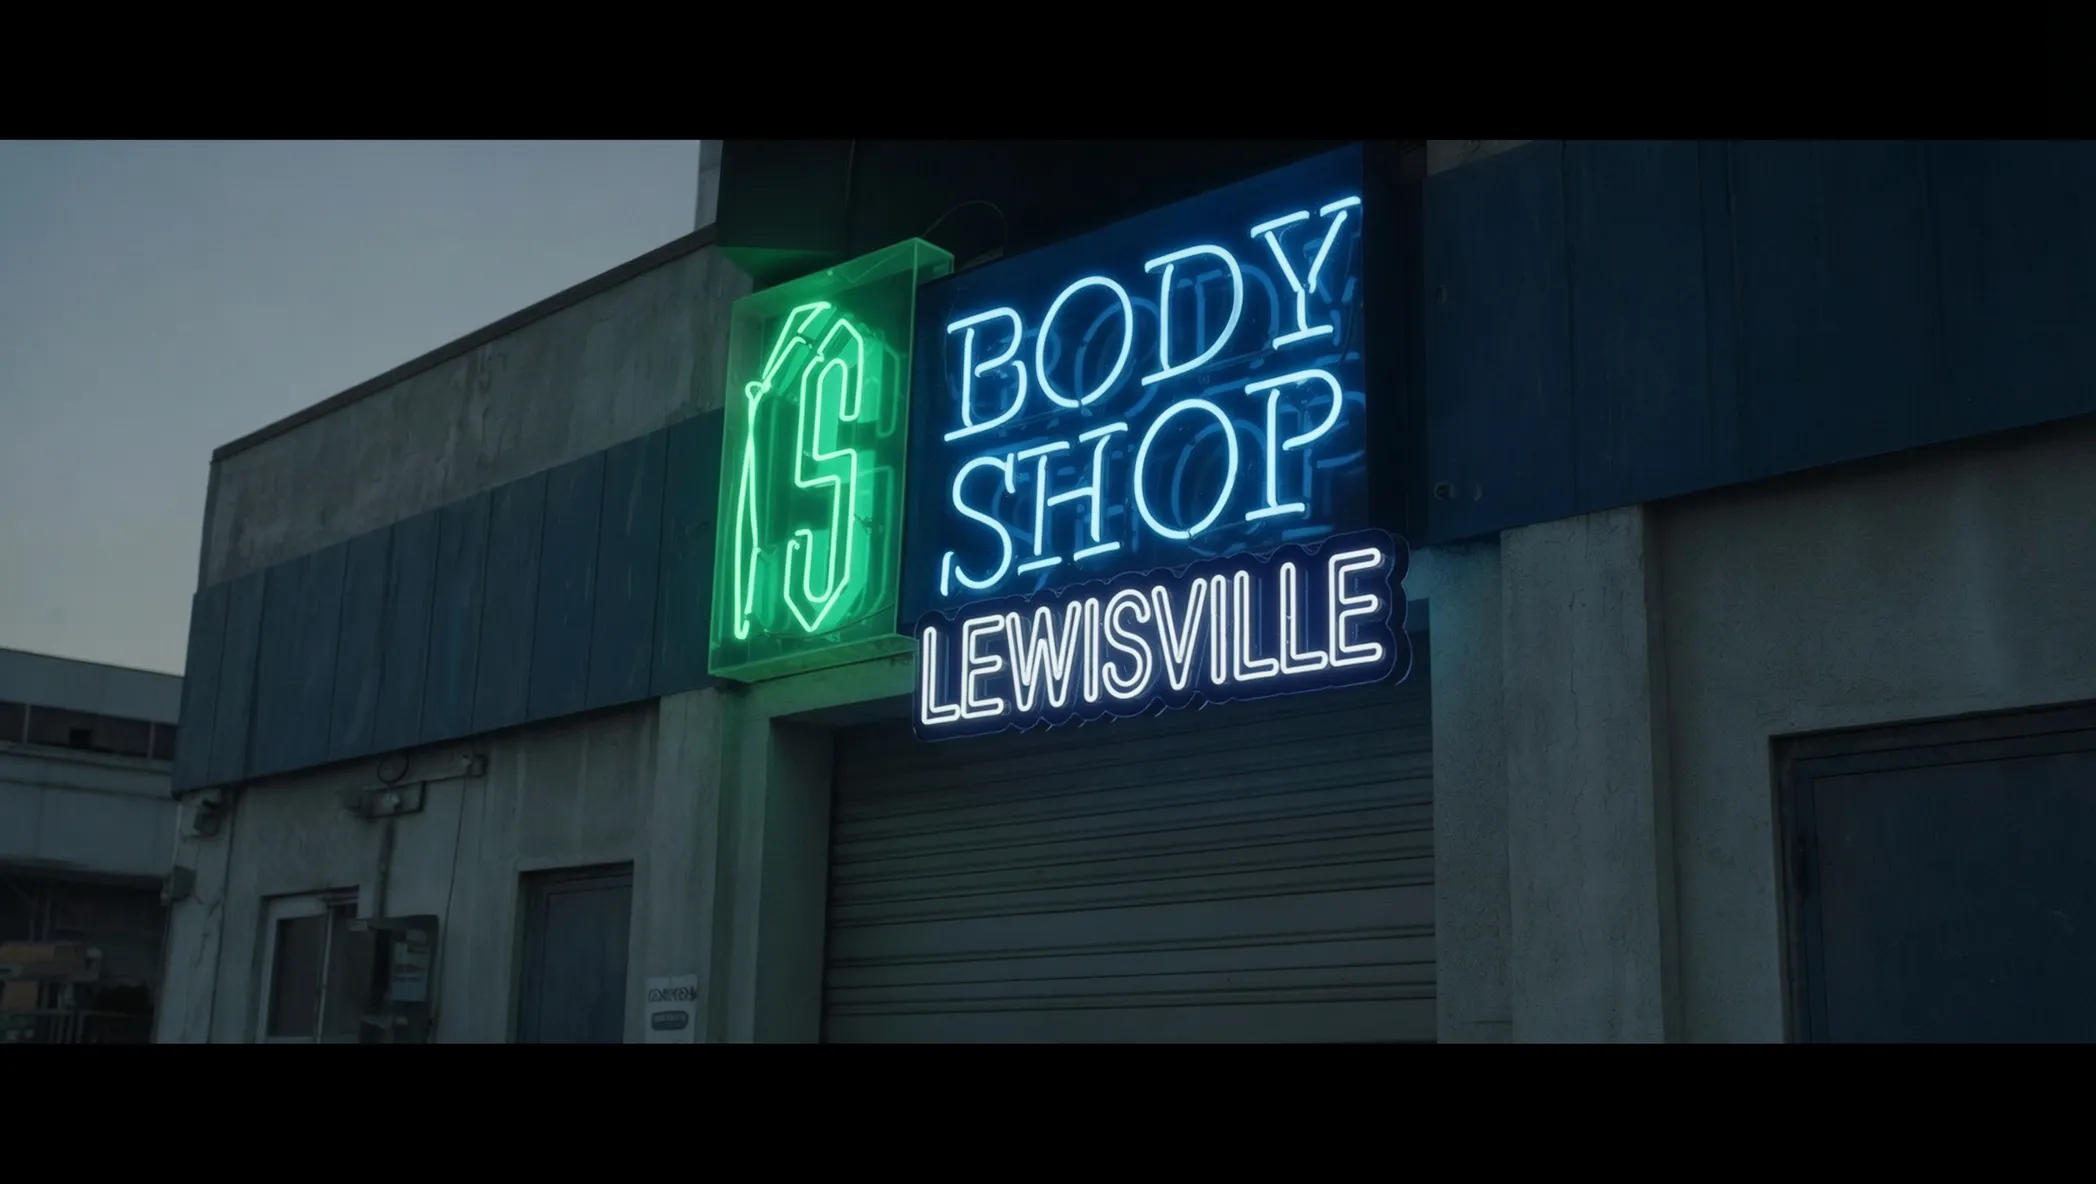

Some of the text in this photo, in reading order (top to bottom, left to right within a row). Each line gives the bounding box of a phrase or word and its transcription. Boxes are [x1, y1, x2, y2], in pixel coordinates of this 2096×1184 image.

[943, 195, 1362, 442] BODY
[940, 369, 1343, 597] SHOP
[920, 546, 1384, 726] LEWISVILLE
